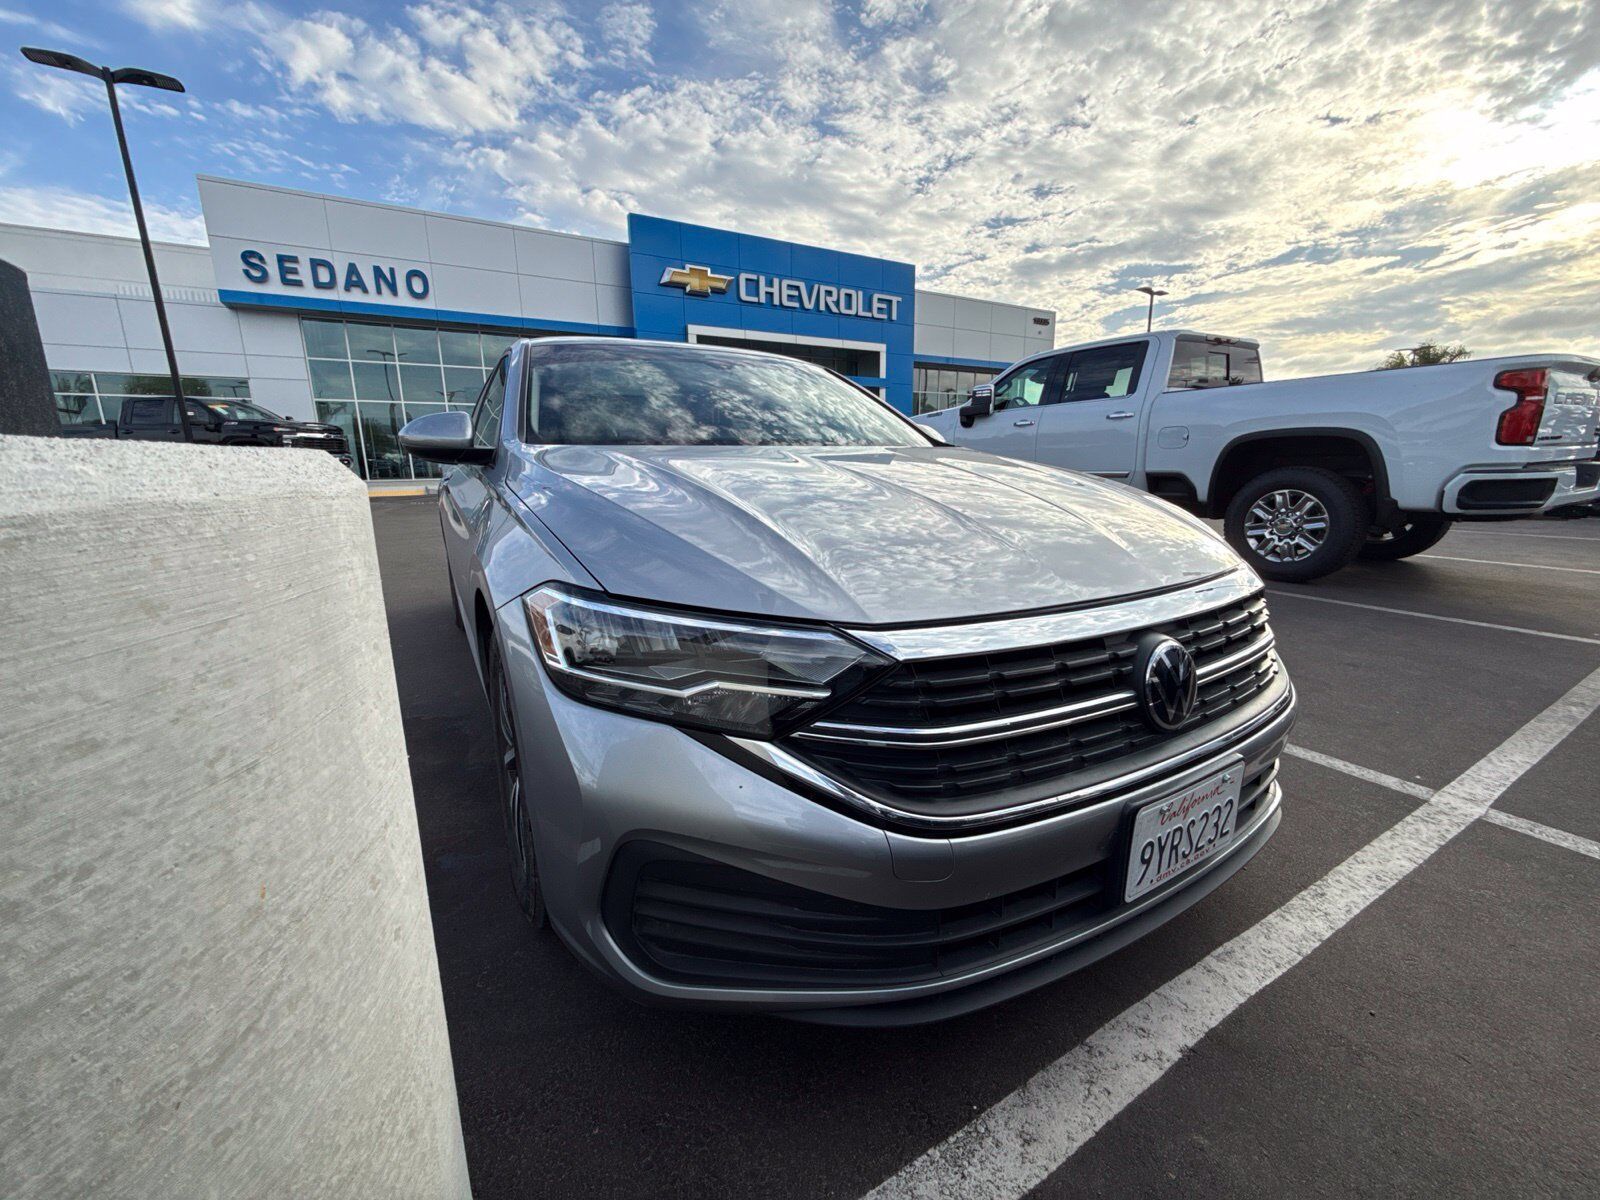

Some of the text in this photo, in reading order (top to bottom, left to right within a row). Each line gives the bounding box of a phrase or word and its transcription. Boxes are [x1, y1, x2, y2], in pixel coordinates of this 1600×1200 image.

[240, 249, 430, 300] SEDANO
[738, 272, 903, 321] CHEVROLET
[1160, 780, 1226, 826] California
[1136, 799, 1234, 886] 9YRS232
